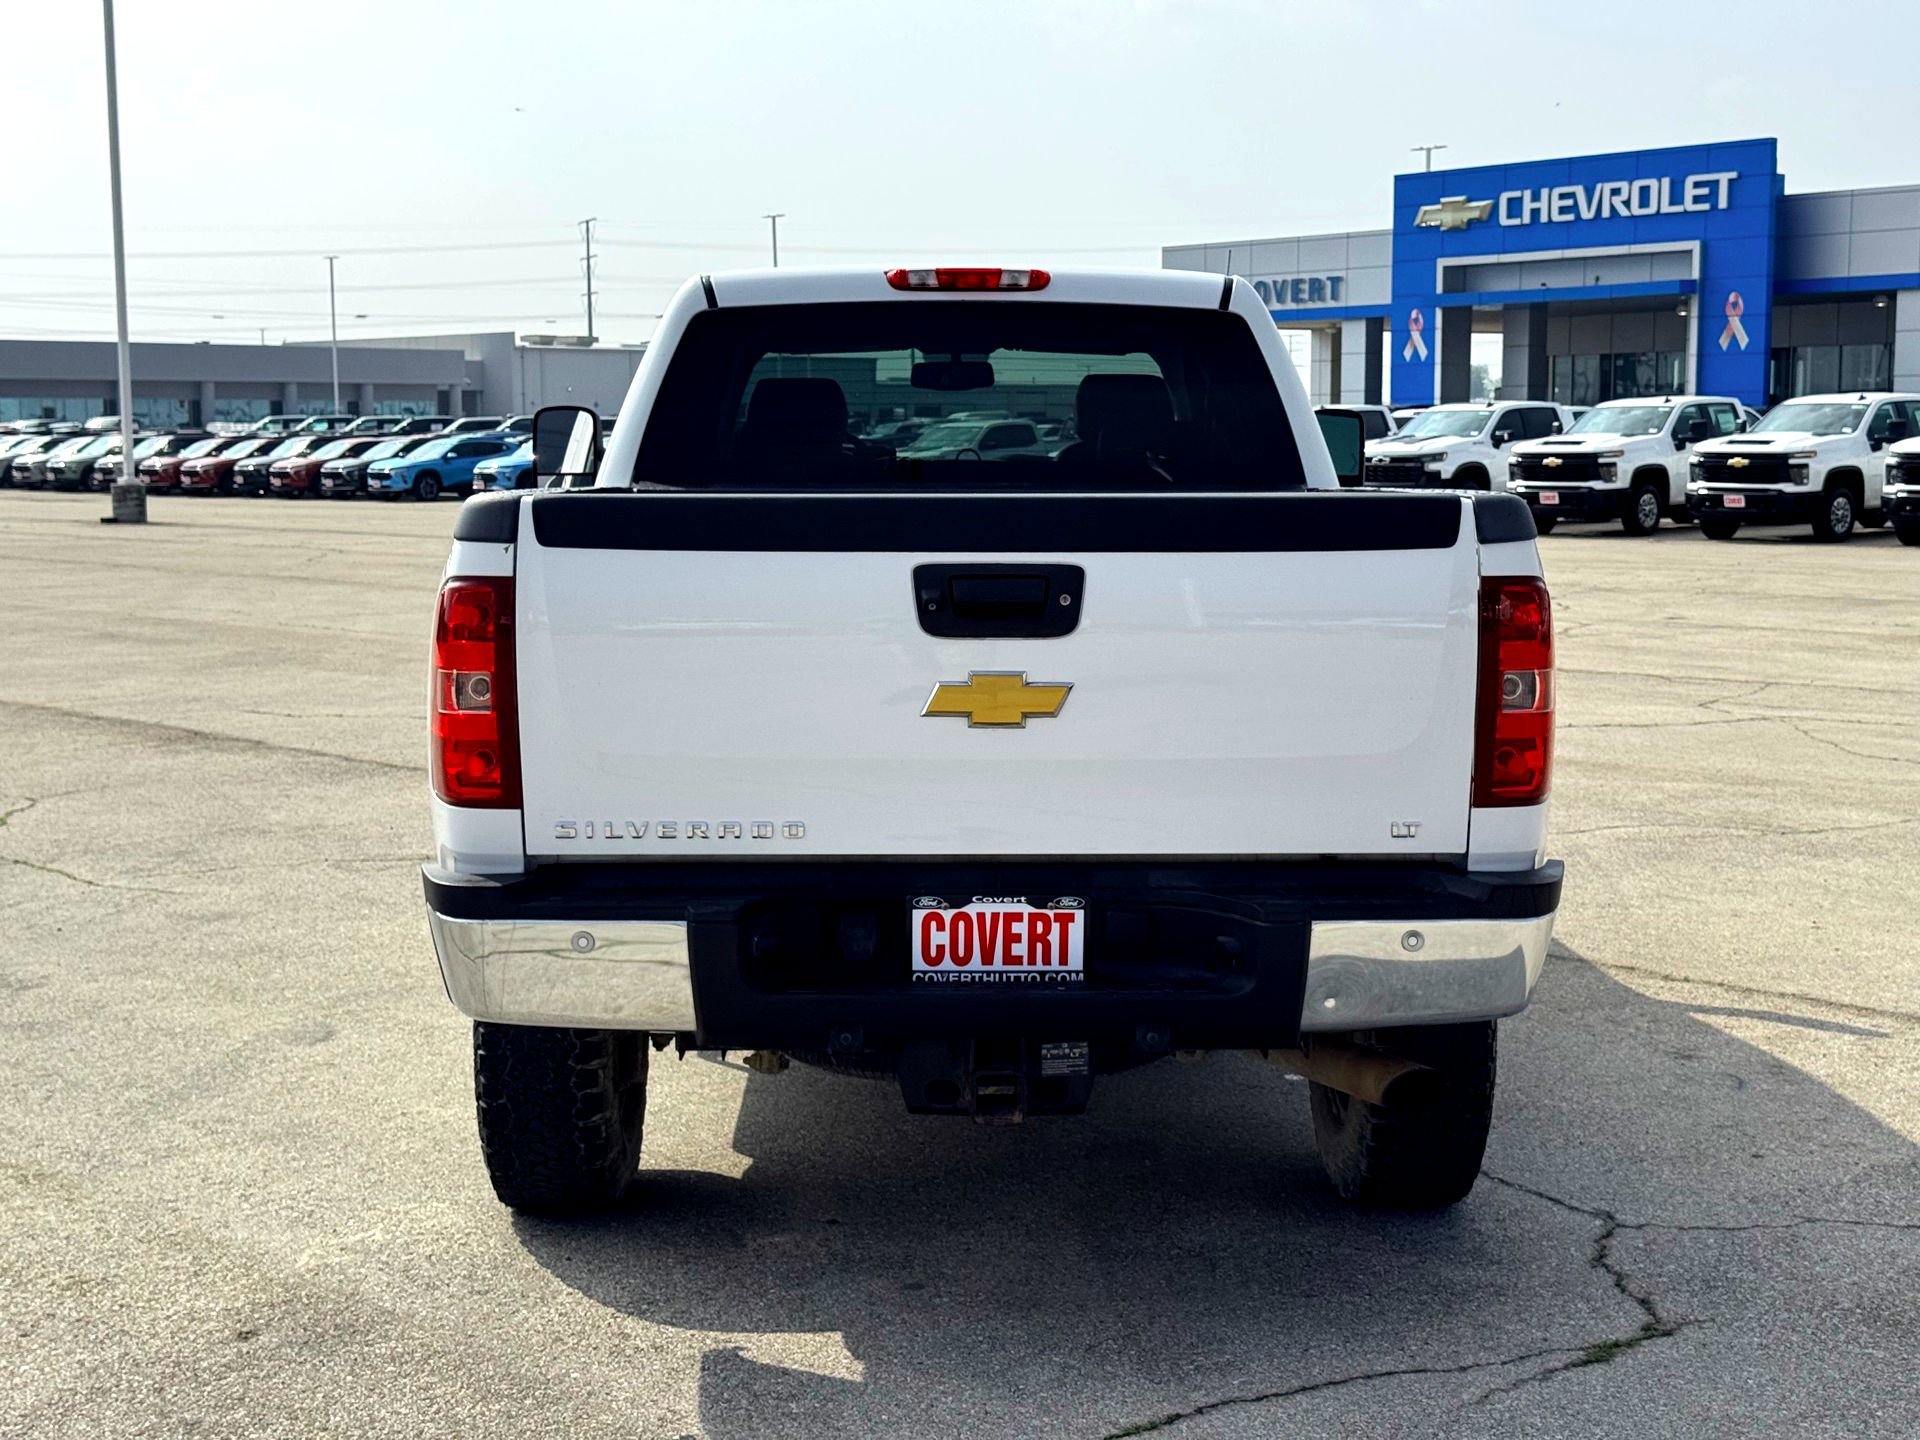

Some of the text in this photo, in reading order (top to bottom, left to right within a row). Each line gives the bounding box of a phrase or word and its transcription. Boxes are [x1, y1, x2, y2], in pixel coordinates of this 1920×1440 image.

[1498, 170, 1740, 227] CHEVROLET
[1253, 275, 1345, 307] OVERT
[554, 820, 806, 839] SILVERADO
[1390, 821, 1423, 838] LT
[972, 895, 1027, 903] Covert
[921, 911, 1076, 967] COVERT
[912, 972, 1084, 982] COVERTHUTTOCOM
